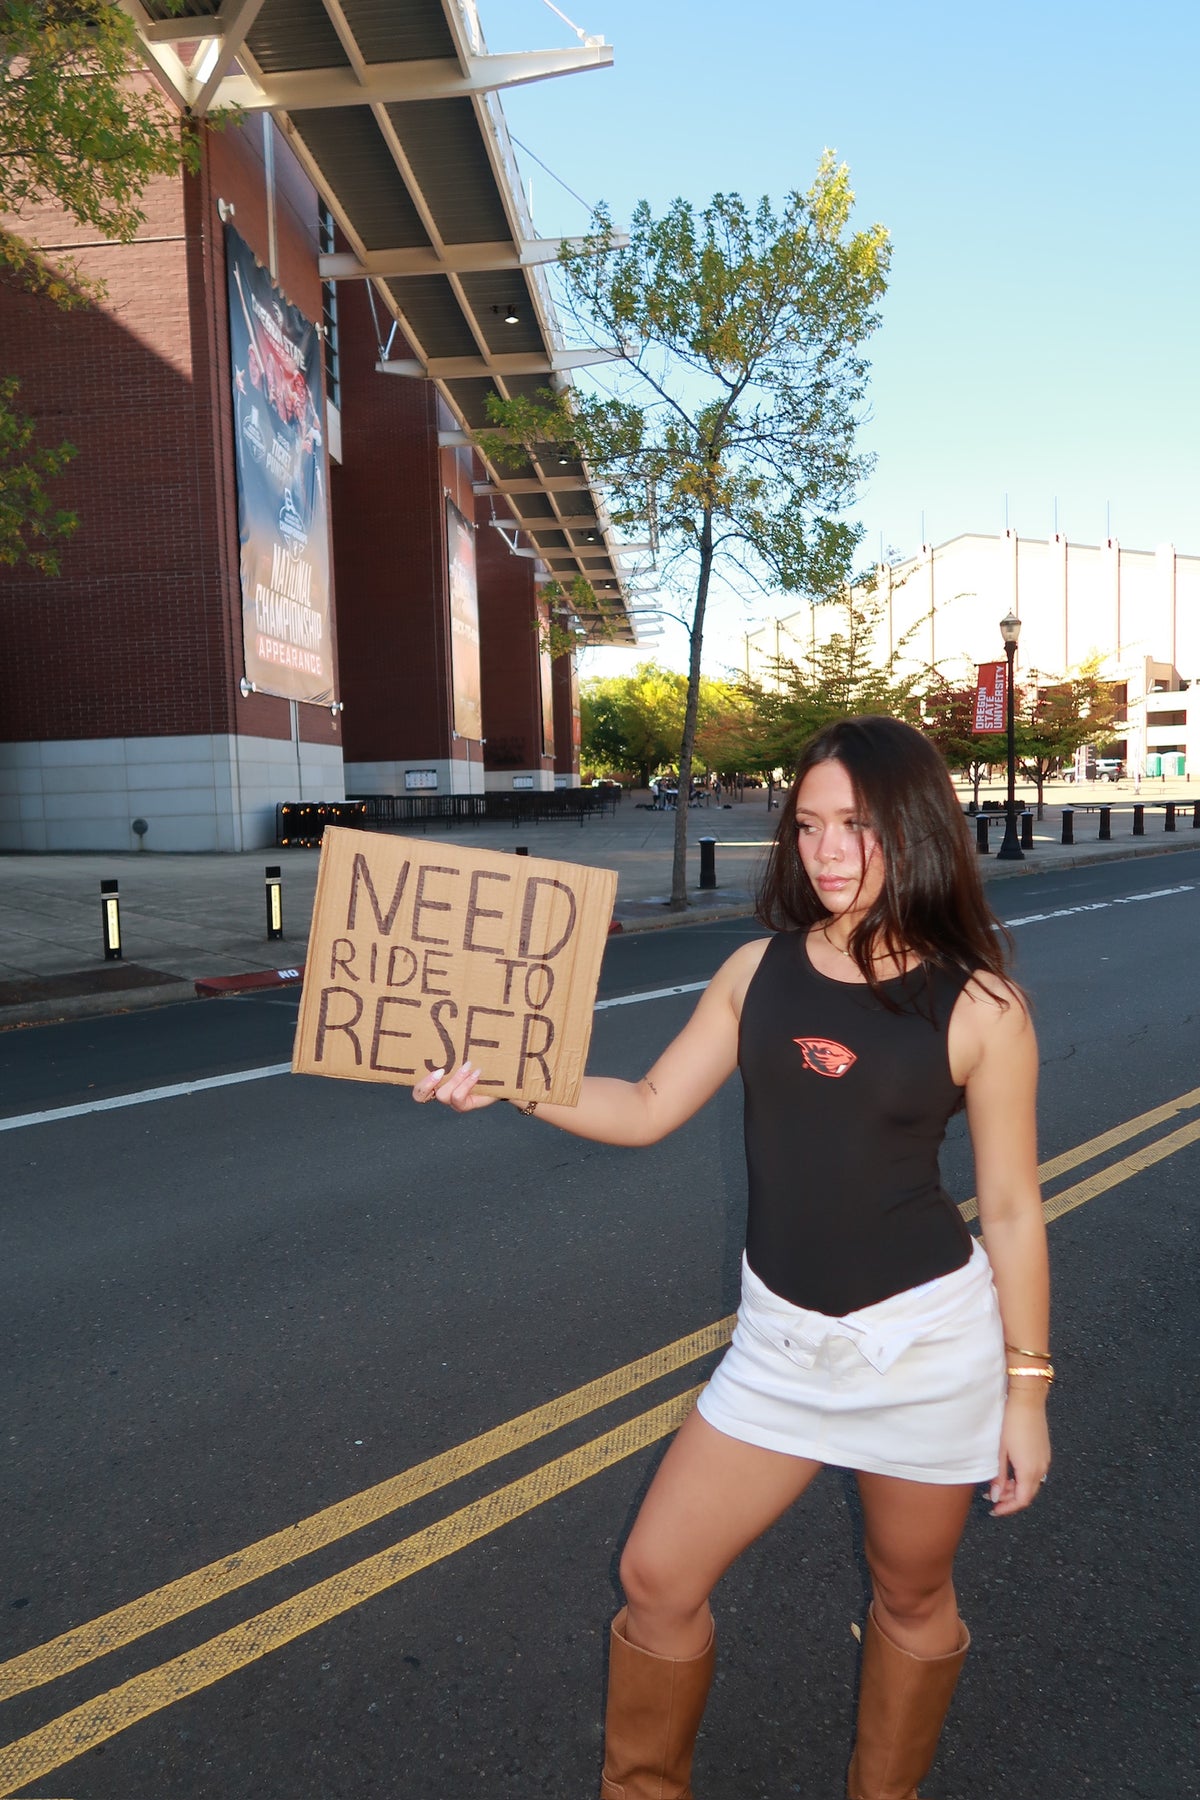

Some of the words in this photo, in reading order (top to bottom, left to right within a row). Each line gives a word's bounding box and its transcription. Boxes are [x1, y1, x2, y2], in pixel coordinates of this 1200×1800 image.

[270, 543, 313, 608] NATIONAL
[255, 583, 321, 651] CHAMPIONSHIP
[258, 638, 322, 675] APPEARANCE
[976, 687, 986, 729] OREGON
[985, 696, 994, 729] STATE
[994, 666, 1004, 729] UNIVERSITY
[346, 852, 577, 961] NEED
[277, 969, 299, 979] NO
[330, 938, 454, 996] RIDE
[495, 958, 555, 1011] TO
[313, 986, 555, 1092] RESER
